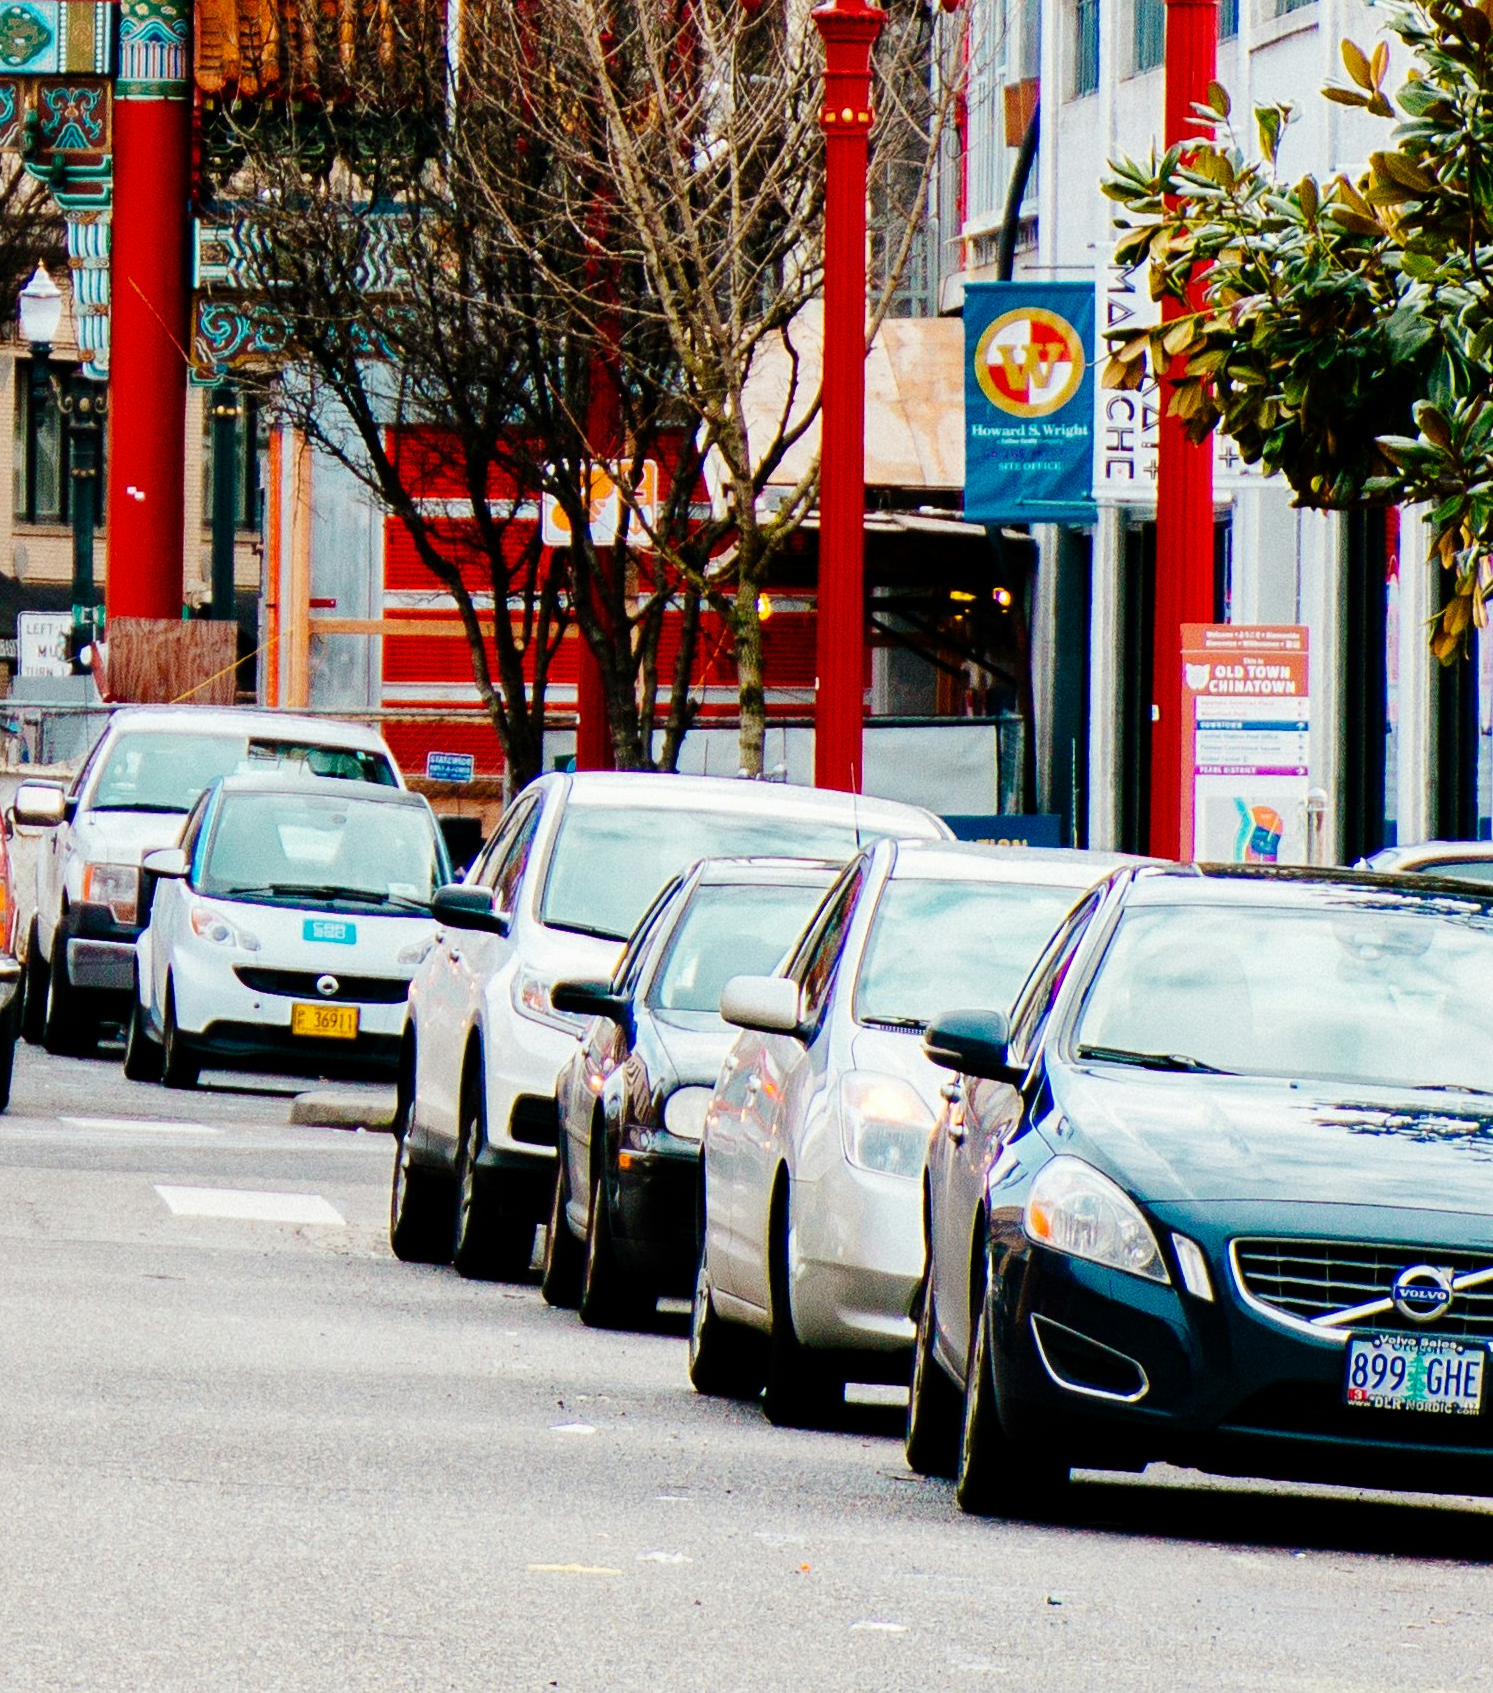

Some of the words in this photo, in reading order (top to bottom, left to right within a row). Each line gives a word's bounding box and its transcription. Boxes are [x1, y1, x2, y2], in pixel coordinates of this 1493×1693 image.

[971, 423, 1026, 437] Howard
[1028, 423, 1041, 437] S.
[1042, 422, 1089, 439] Wright
[1214, 665, 1245, 678] OLD
[1247, 665, 1291, 679] TOWN
[1208, 679, 1296, 694] CHINATOWN
[1398, 1288, 1447, 1301] VOLVO
[1378, 1334, 1417, 1347] Volvo
[1419, 1336, 1458, 1352] Sales
[1351, 1352, 1407, 1392] 899
[1426, 1357, 1481, 1399] GHE
